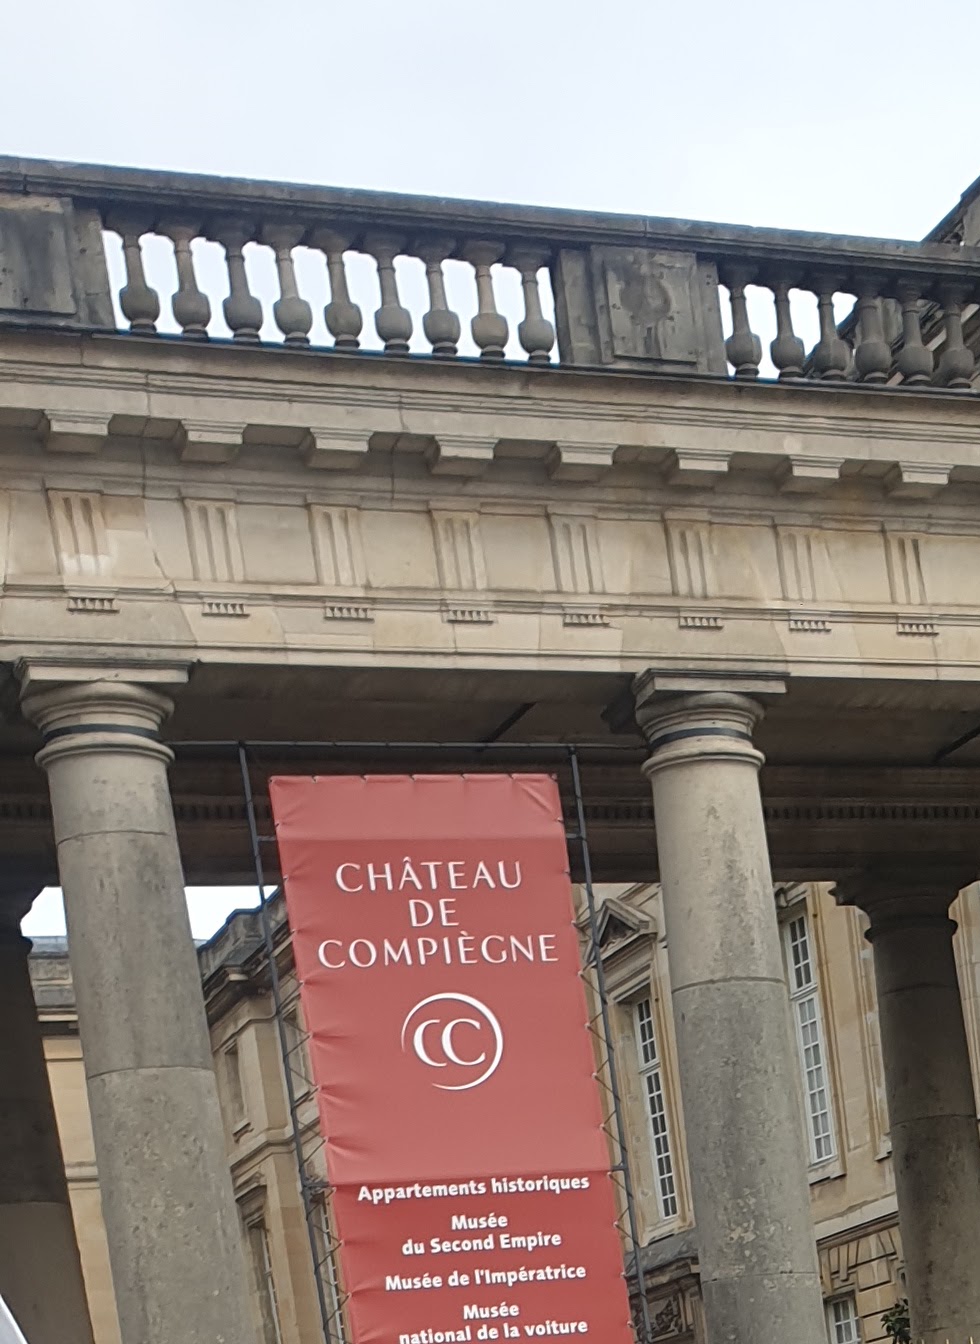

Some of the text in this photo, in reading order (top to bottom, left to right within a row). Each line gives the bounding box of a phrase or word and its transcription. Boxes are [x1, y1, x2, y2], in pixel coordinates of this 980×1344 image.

[335, 856, 522, 892] CHÂTEAU
[408, 898, 459, 928] DE
[318, 930, 559, 969] COMPIÈGNE
[357, 1174, 590, 1205] Appartements historiques
[451, 1212, 508, 1231] Musée
[401, 1231, 562, 1256] du Second Empire
[385, 1263, 587, 1291] Musée de l'Impératrice
[463, 1301, 520, 1320] Musée
[476, 1323, 499, 1341] de
[503, 1322, 521, 1339] la
[524, 1318, 588, 1337] voiture
